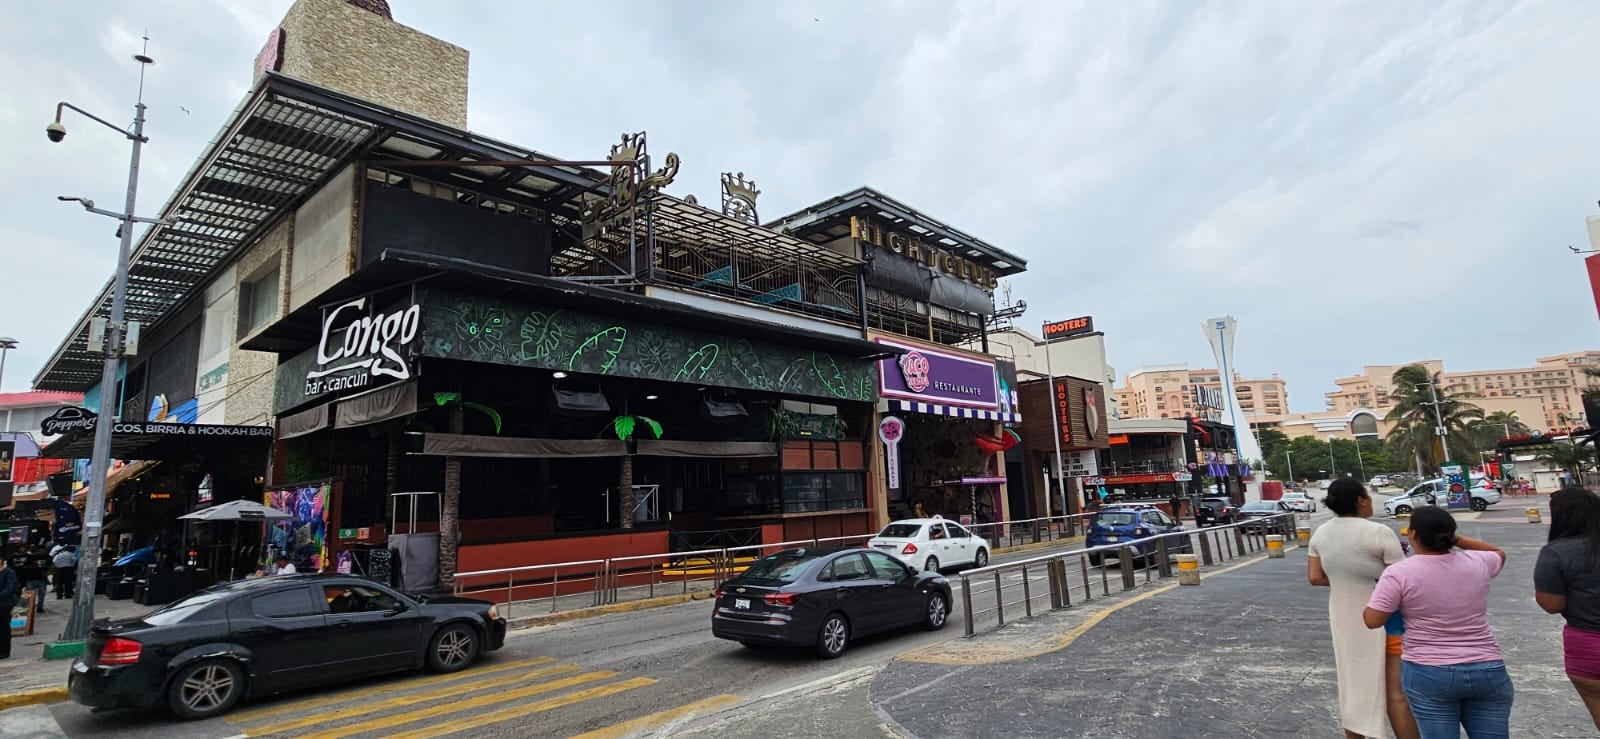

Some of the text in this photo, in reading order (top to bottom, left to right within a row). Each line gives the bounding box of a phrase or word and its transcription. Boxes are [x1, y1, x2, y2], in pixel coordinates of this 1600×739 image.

[850, 215, 998, 288] NIGHTCLUB
[1044, 318, 1087, 334] HOOTERS
[316, 297, 421, 379] Congo
[305, 379, 323, 396] bar
[934, 381, 982, 396] RESTAURANTE
[1057, 383, 1070, 443] HOOTERS
[146, 424, 186, 434] BIRRIA
[188, 427, 196, 435] &
[197, 426, 248, 436] HOOKAH
[249, 427, 273, 436] BAR
